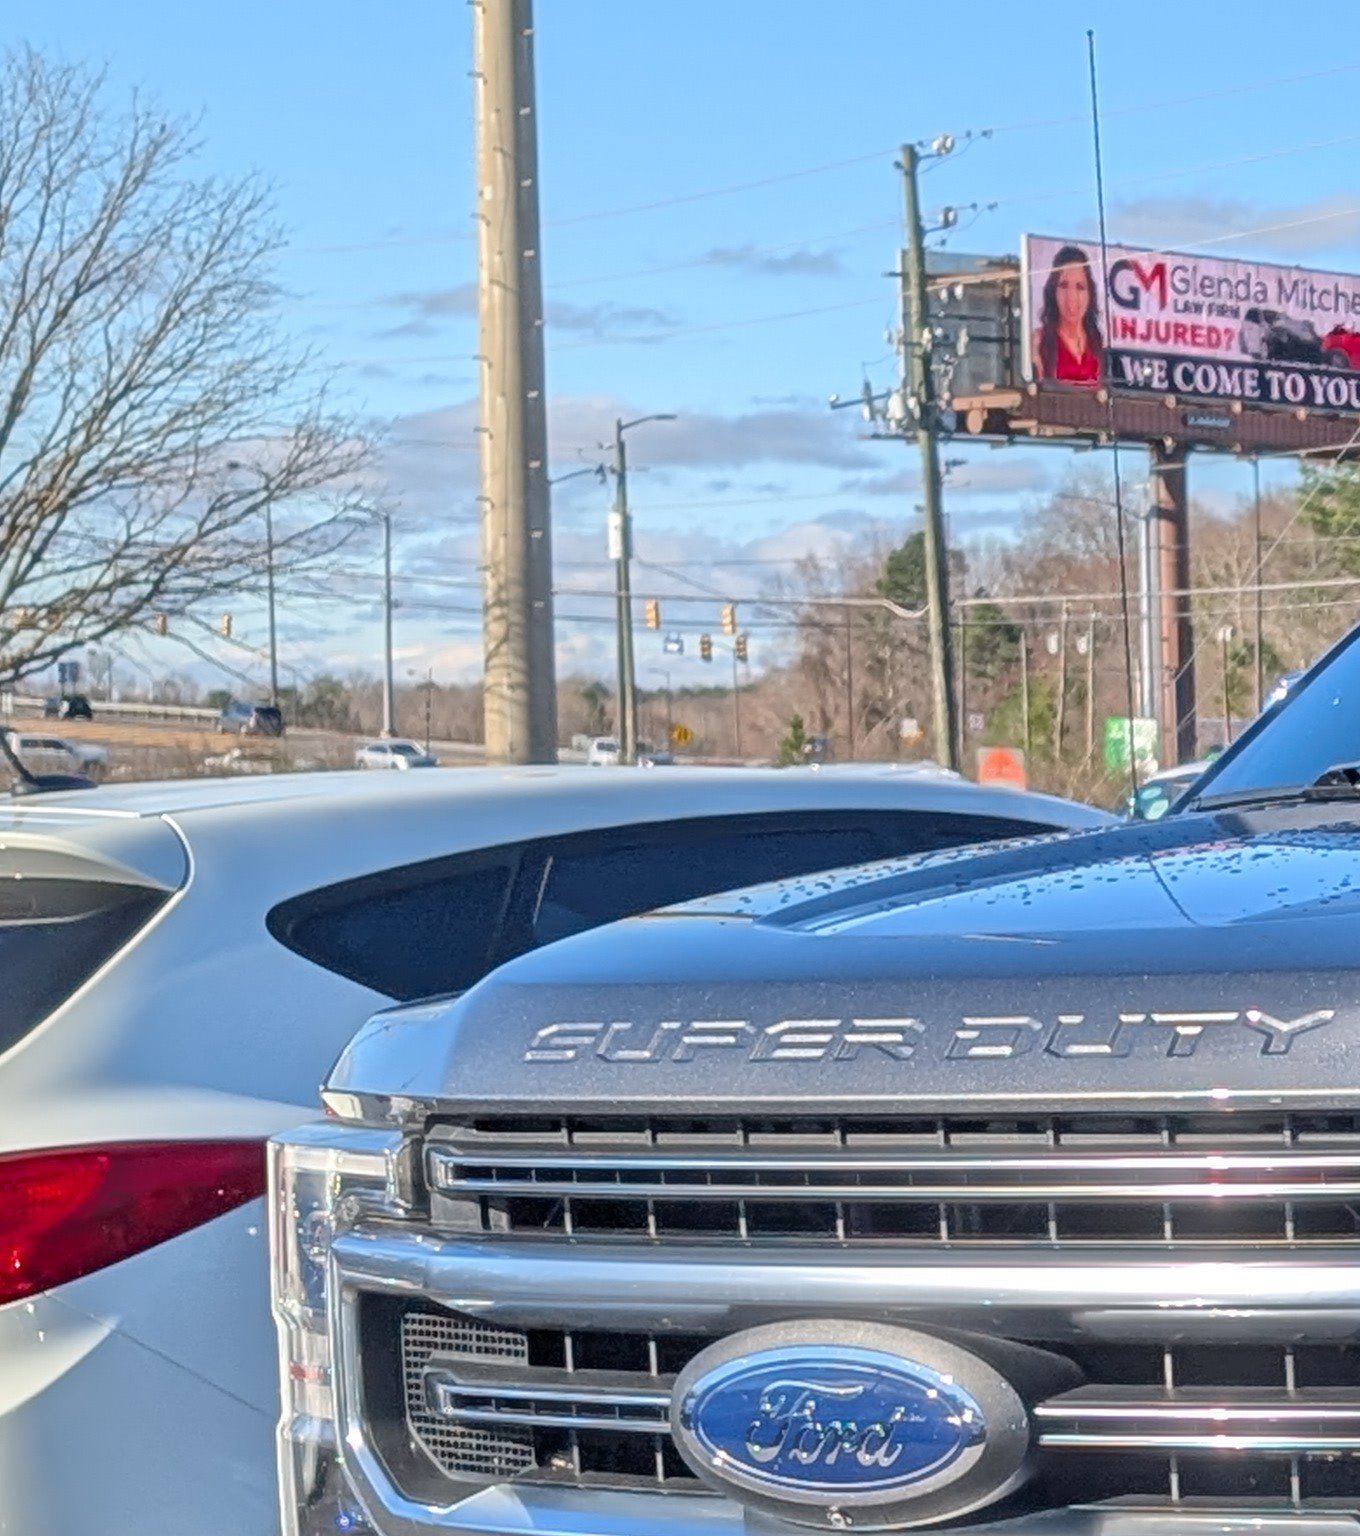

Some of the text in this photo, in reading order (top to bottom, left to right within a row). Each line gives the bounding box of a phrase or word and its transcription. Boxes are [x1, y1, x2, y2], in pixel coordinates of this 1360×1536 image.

[1171, 265, 1268, 304] Glenda
[1173, 299, 1240, 319] LAW FIRM
[1112, 316, 1235, 351] INJURED?
[1119, 355, 1169, 389] WE
[1173, 361, 1261, 398] COME
[1265, 370, 1306, 402] TO
[523, 1008, 1335, 1063] SUPER DUTY
[745, 1379, 905, 1468] Ford
